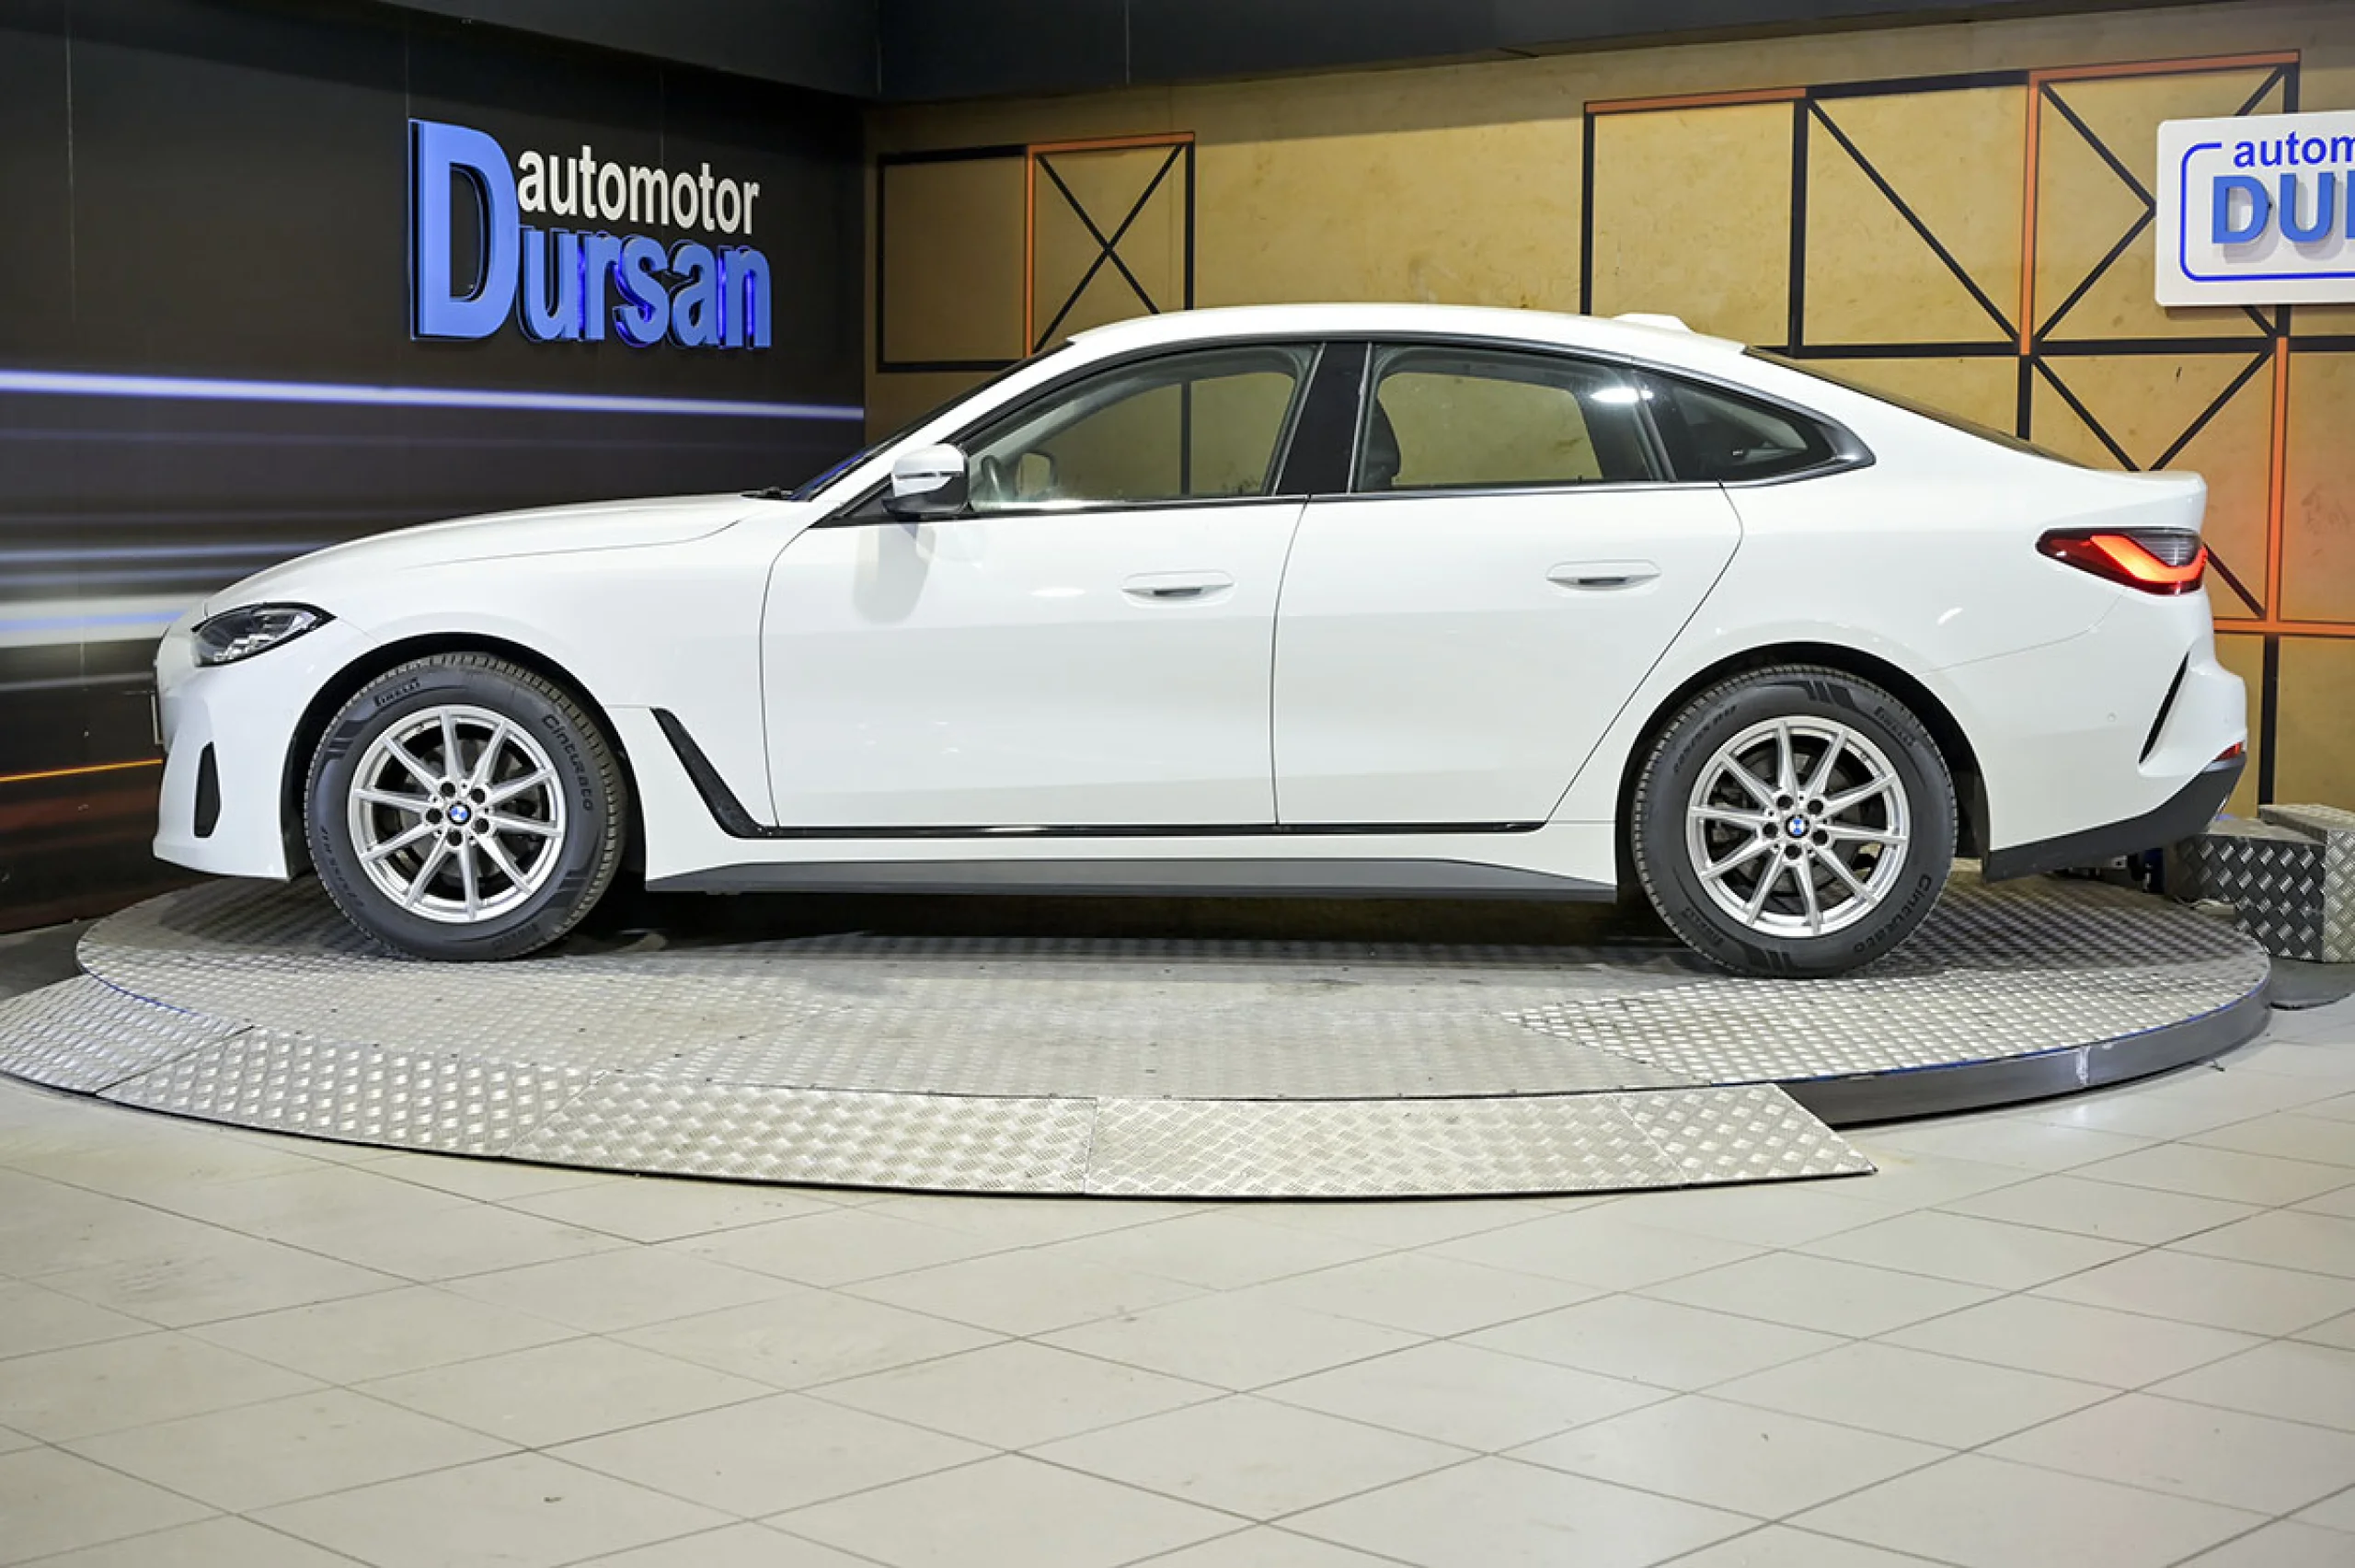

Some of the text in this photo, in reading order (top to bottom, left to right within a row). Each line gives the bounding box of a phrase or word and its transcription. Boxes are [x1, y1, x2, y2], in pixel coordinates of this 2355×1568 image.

[408, 117, 772, 350] Dursan
[517, 144, 760, 235] automotor
[2211, 169, 2355, 245] DU
